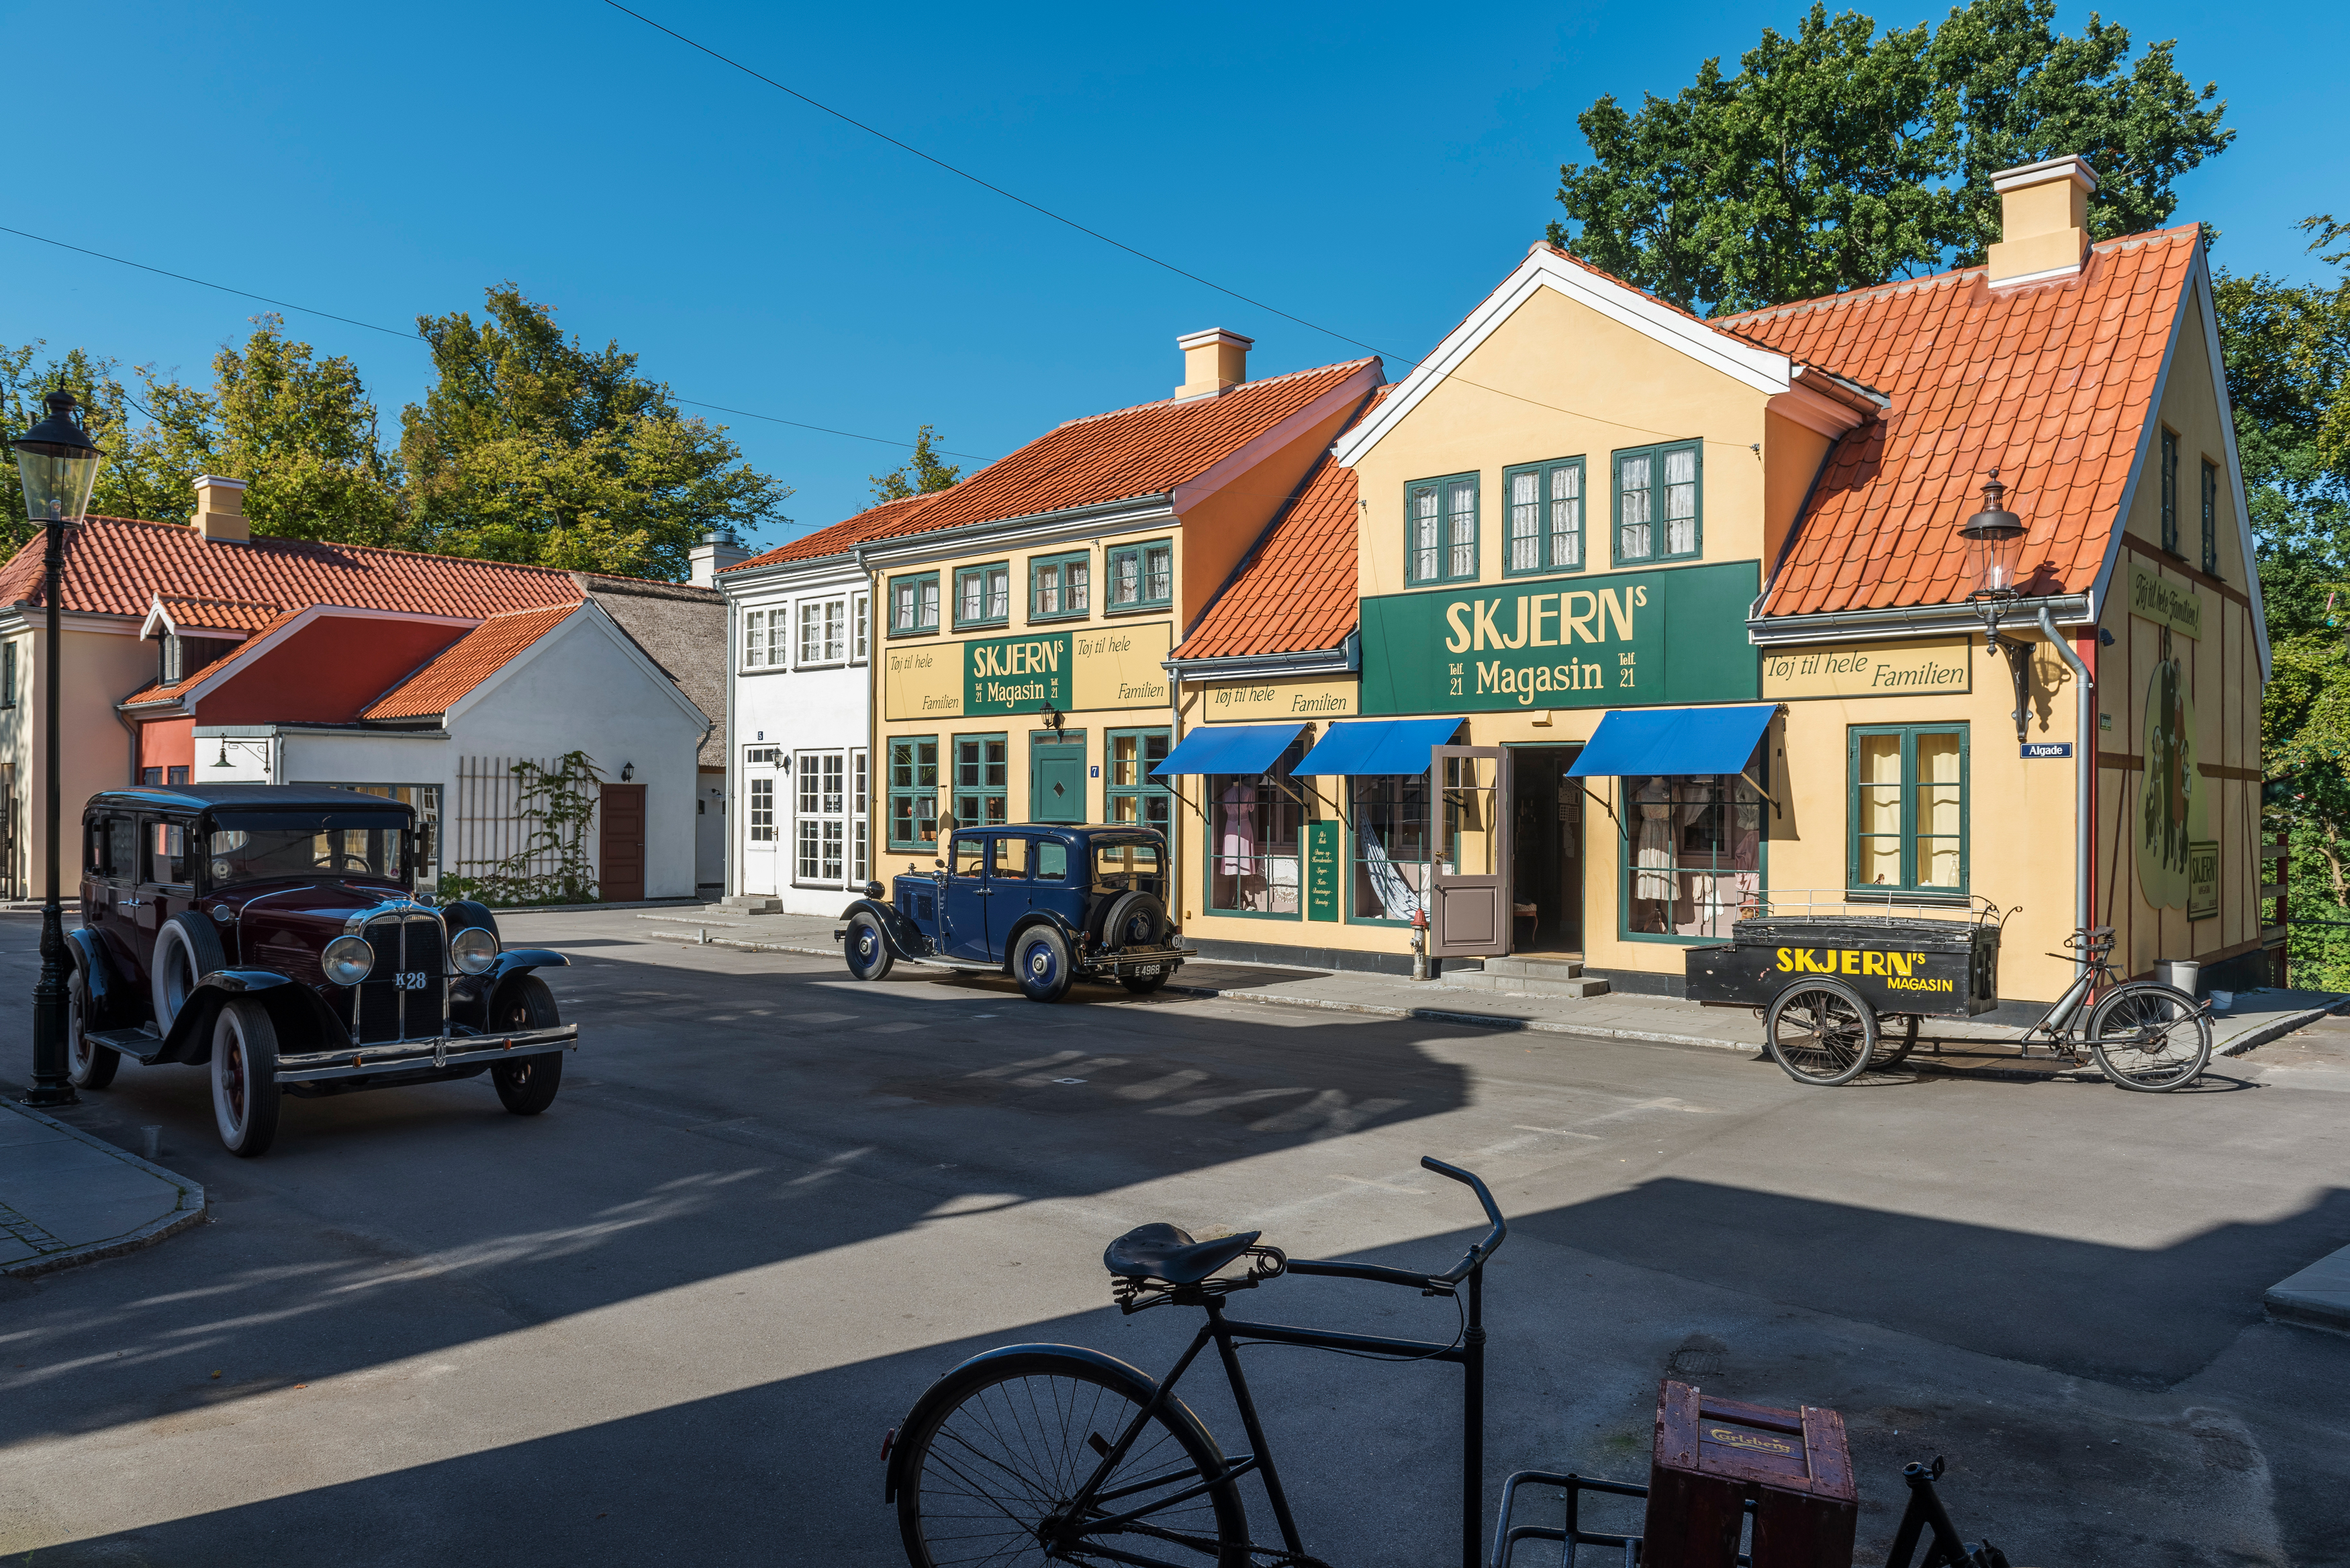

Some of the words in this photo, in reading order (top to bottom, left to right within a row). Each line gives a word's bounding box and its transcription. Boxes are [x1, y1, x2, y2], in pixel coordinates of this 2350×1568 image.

[2136, 573, 2148, 610] Tøj
[2149, 580, 2157, 608] til
[2156, 585, 2169, 614] hele
[1078, 639, 1093, 658] Tøj
[1095, 637, 1106, 653] til
[1109, 636, 1131, 652] hele
[891, 656, 902, 673] Tøj
[904, 655, 913, 669] til
[915, 653, 933, 669] hele
[1618, 652, 1636, 666] Telf.
[1448, 663, 1464, 675] Telf.
[1767, 655, 1796, 681] Tøj
[1800, 652, 1821, 675] til
[1824, 650, 1868, 674] hele
[1871, 661, 1964, 687] Familien
[1450, 677, 1463, 695] 21
[1476, 657, 1604, 705] Magasin
[1619, 668, 1636, 687] 21
[976, 692, 982, 703] 21
[987, 680, 1045, 708] Magasin
[1051, 687, 1058, 699] 21
[1118, 681, 1164, 699] Familien
[1215, 687, 1232, 707] Tøj
[1235, 685, 1247, 703] til
[1249, 683, 1275, 701] hele
[1291, 693, 1346, 712] Familien
[922, 695, 959, 709] Familien
[758, 732, 762, 740] 5
[2028, 746, 2063, 756] Algade
[1092, 767, 1097, 777] 7
[1174, 936, 1183, 946] DK
[1141, 964, 1160, 976] 4968
[395, 973, 406, 985] K
[406, 972, 426, 989] 28
[1887, 977, 1953, 992] MAGASIN
[1710, 1429, 1790, 1453] Carlsberg
